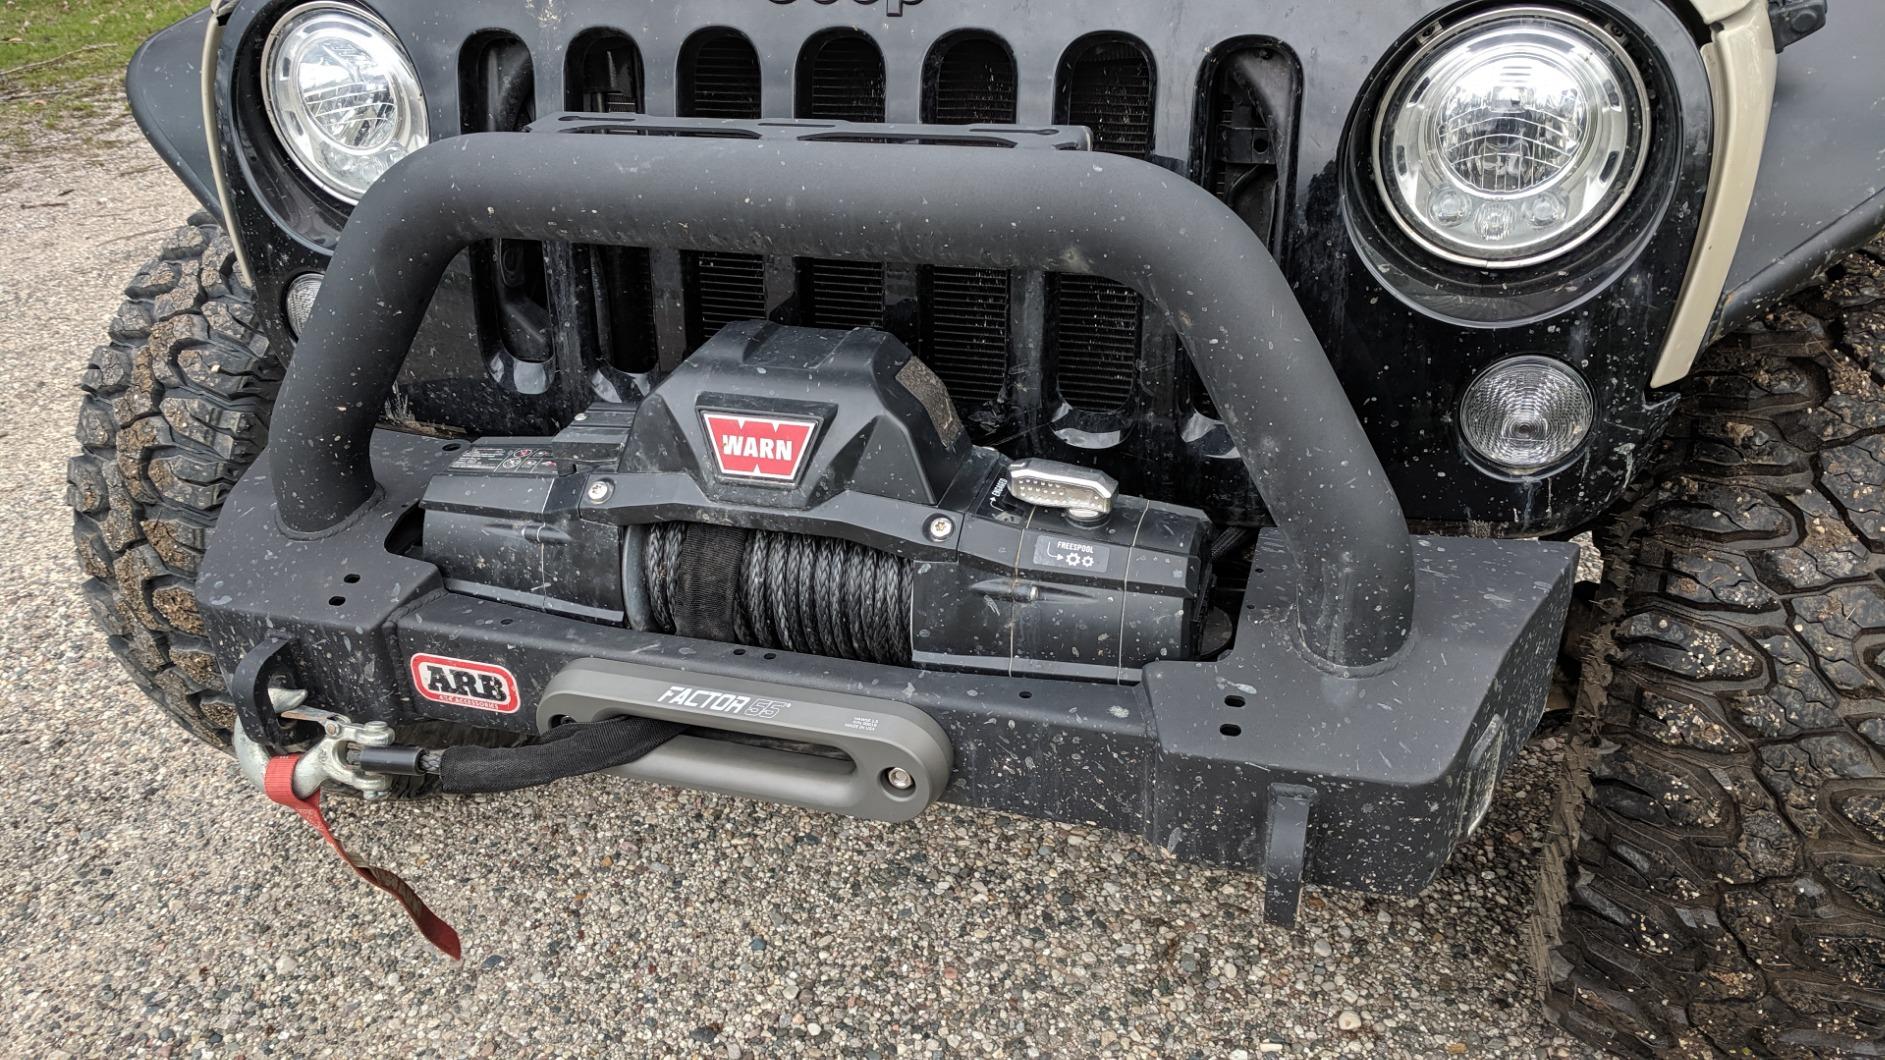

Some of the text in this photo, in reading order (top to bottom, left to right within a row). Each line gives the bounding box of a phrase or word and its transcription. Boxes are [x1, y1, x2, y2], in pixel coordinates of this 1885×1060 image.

[722, 434, 792, 461] WARN
[1056, 541, 1094, 554] FREESPOOL
[426, 665, 507, 702] ARB
[657, 686, 751, 714] FACTOR
